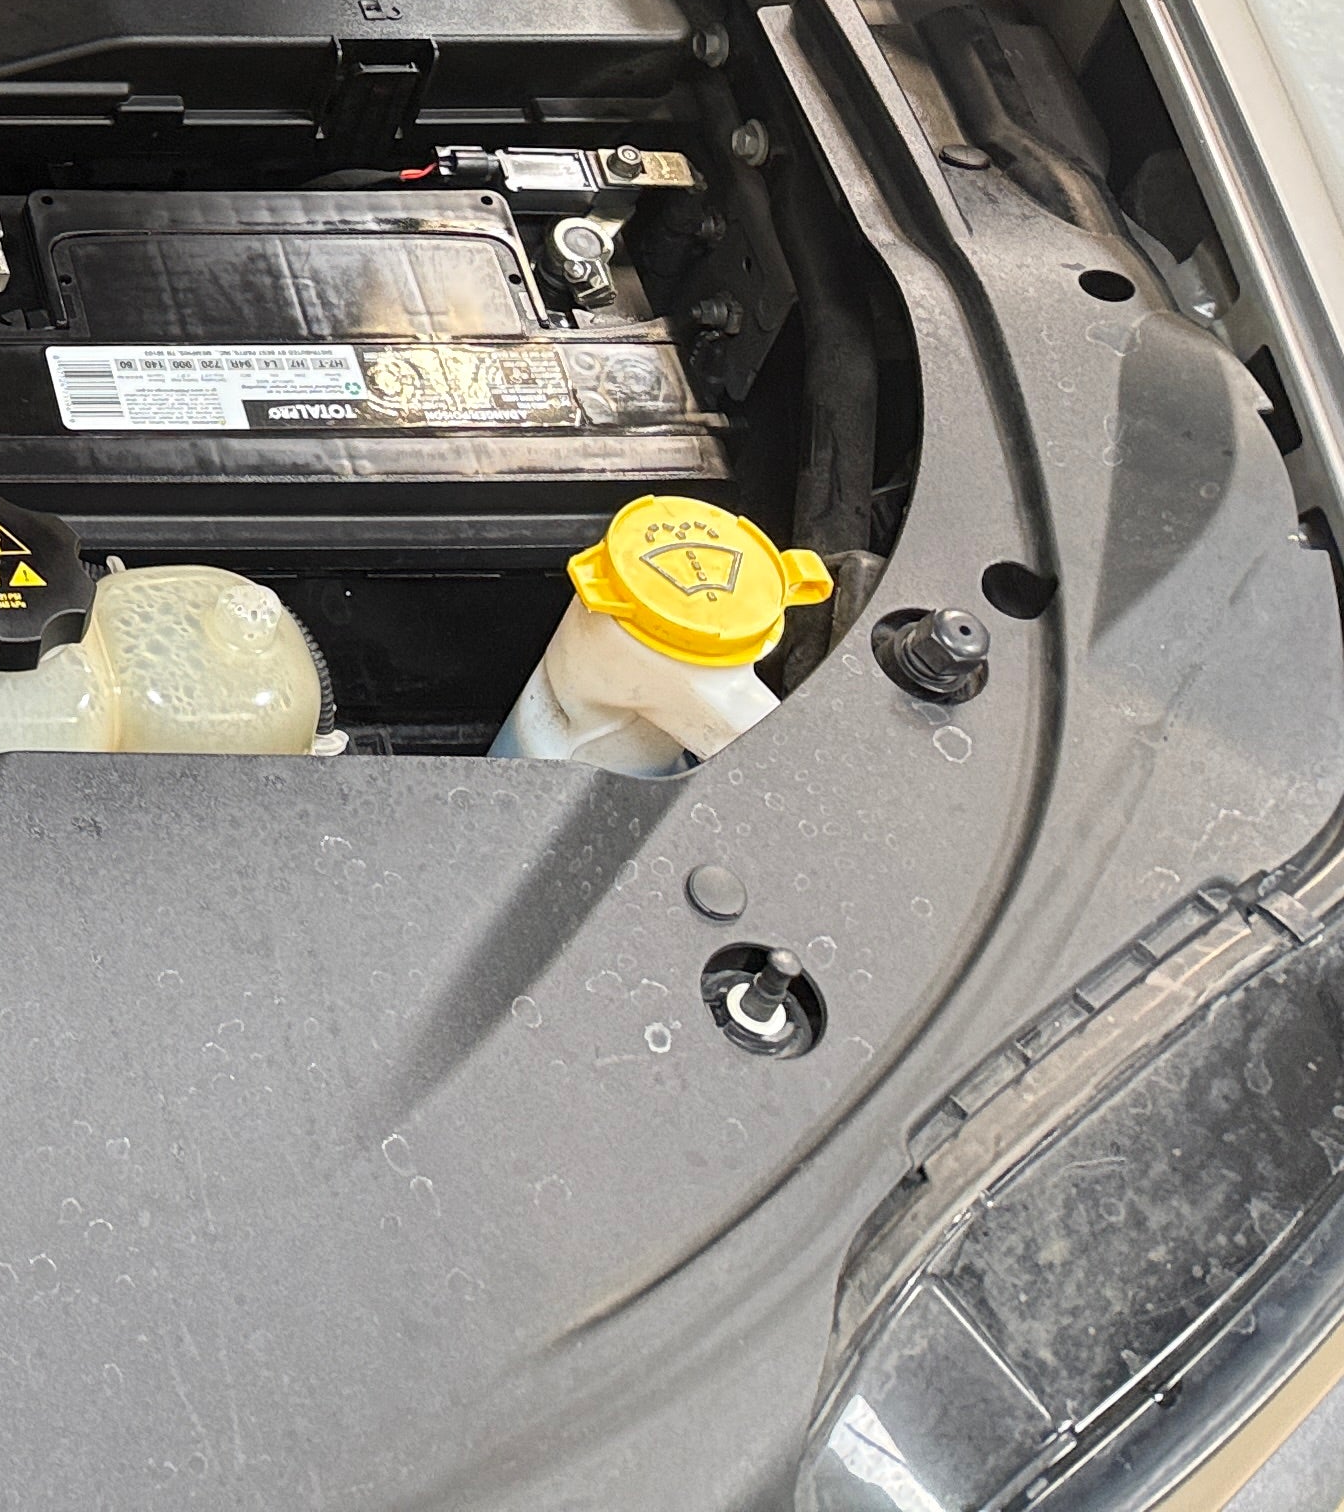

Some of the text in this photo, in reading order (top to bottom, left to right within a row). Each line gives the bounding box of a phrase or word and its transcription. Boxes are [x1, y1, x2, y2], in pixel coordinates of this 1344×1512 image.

[144, 359, 164, 369] 140
[200, 359, 221, 369] 720
[263, 359, 278, 369] L4
[290, 359, 306, 369] H7
[268, 406, 357, 420] TOTALPRO
